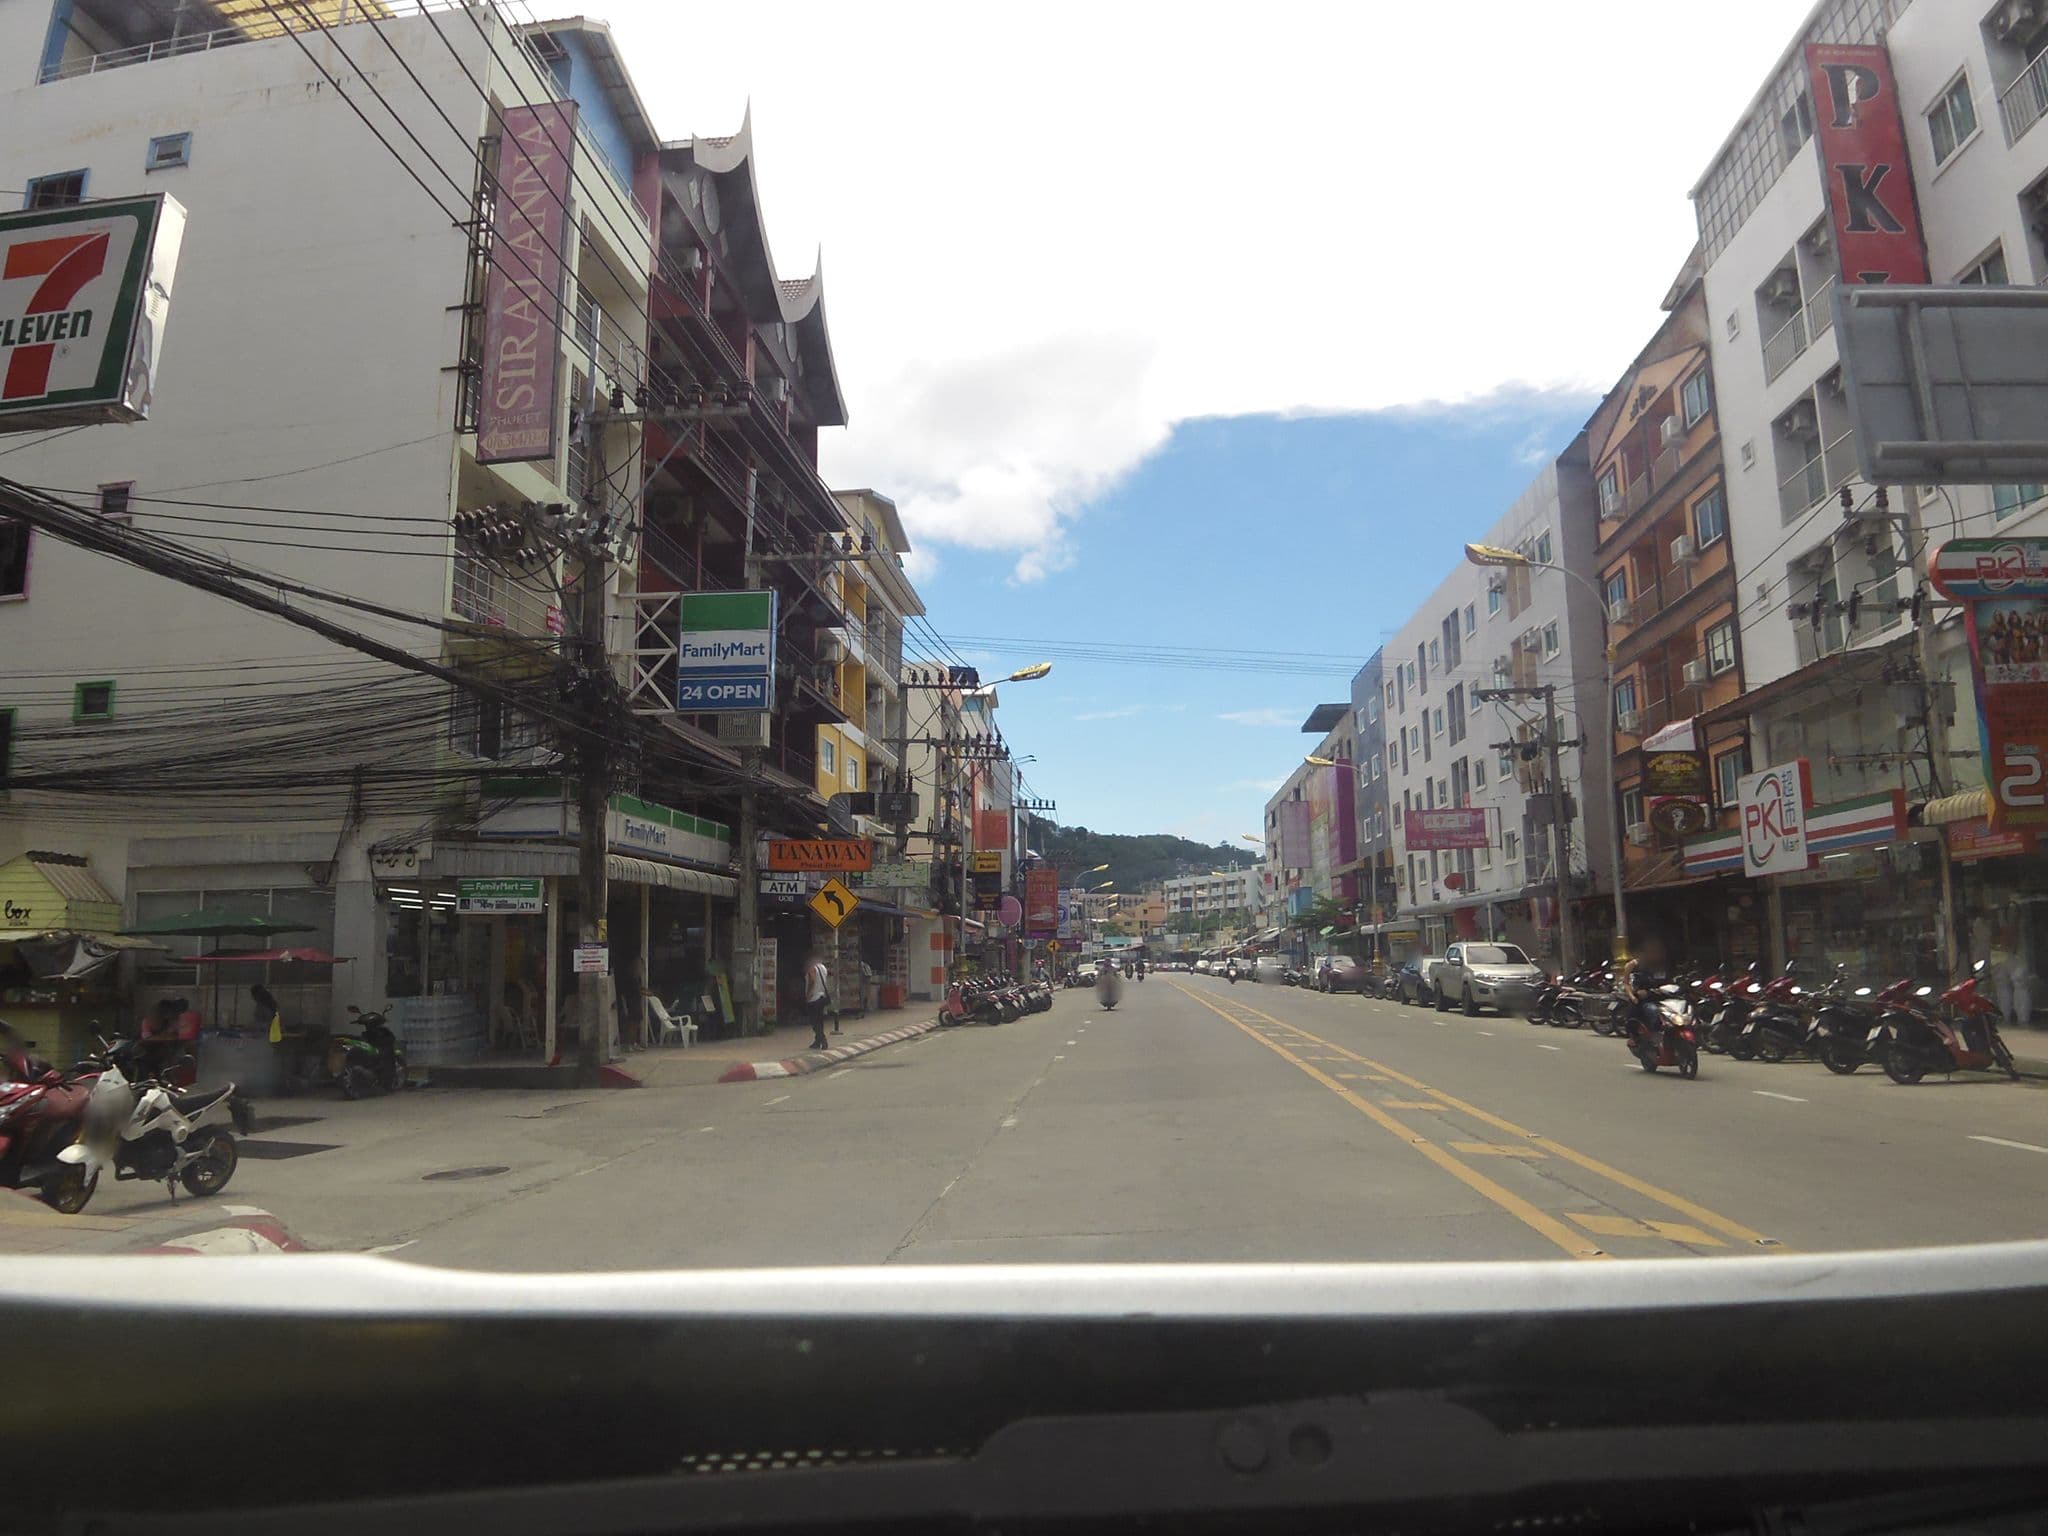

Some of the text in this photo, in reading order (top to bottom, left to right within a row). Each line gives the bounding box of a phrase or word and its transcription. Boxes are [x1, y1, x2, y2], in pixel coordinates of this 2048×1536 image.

[1820, 64, 1905, 283] PK
[496, 118, 555, 410] SIRALANNA
[3, 232, 110, 400] 7
[1975, 552, 2045, 580] PKL
[682, 642, 766, 661] FamilyMart
[682, 685, 761, 699] 24 OPEN
[625, 819, 666, 847] FamilyMart
[1745, 798, 1798, 842] PKL
[775, 843, 866, 861] TANAWAN
[476, 882, 518, 890] FamilyMart
[770, 883, 798, 893] ATM
